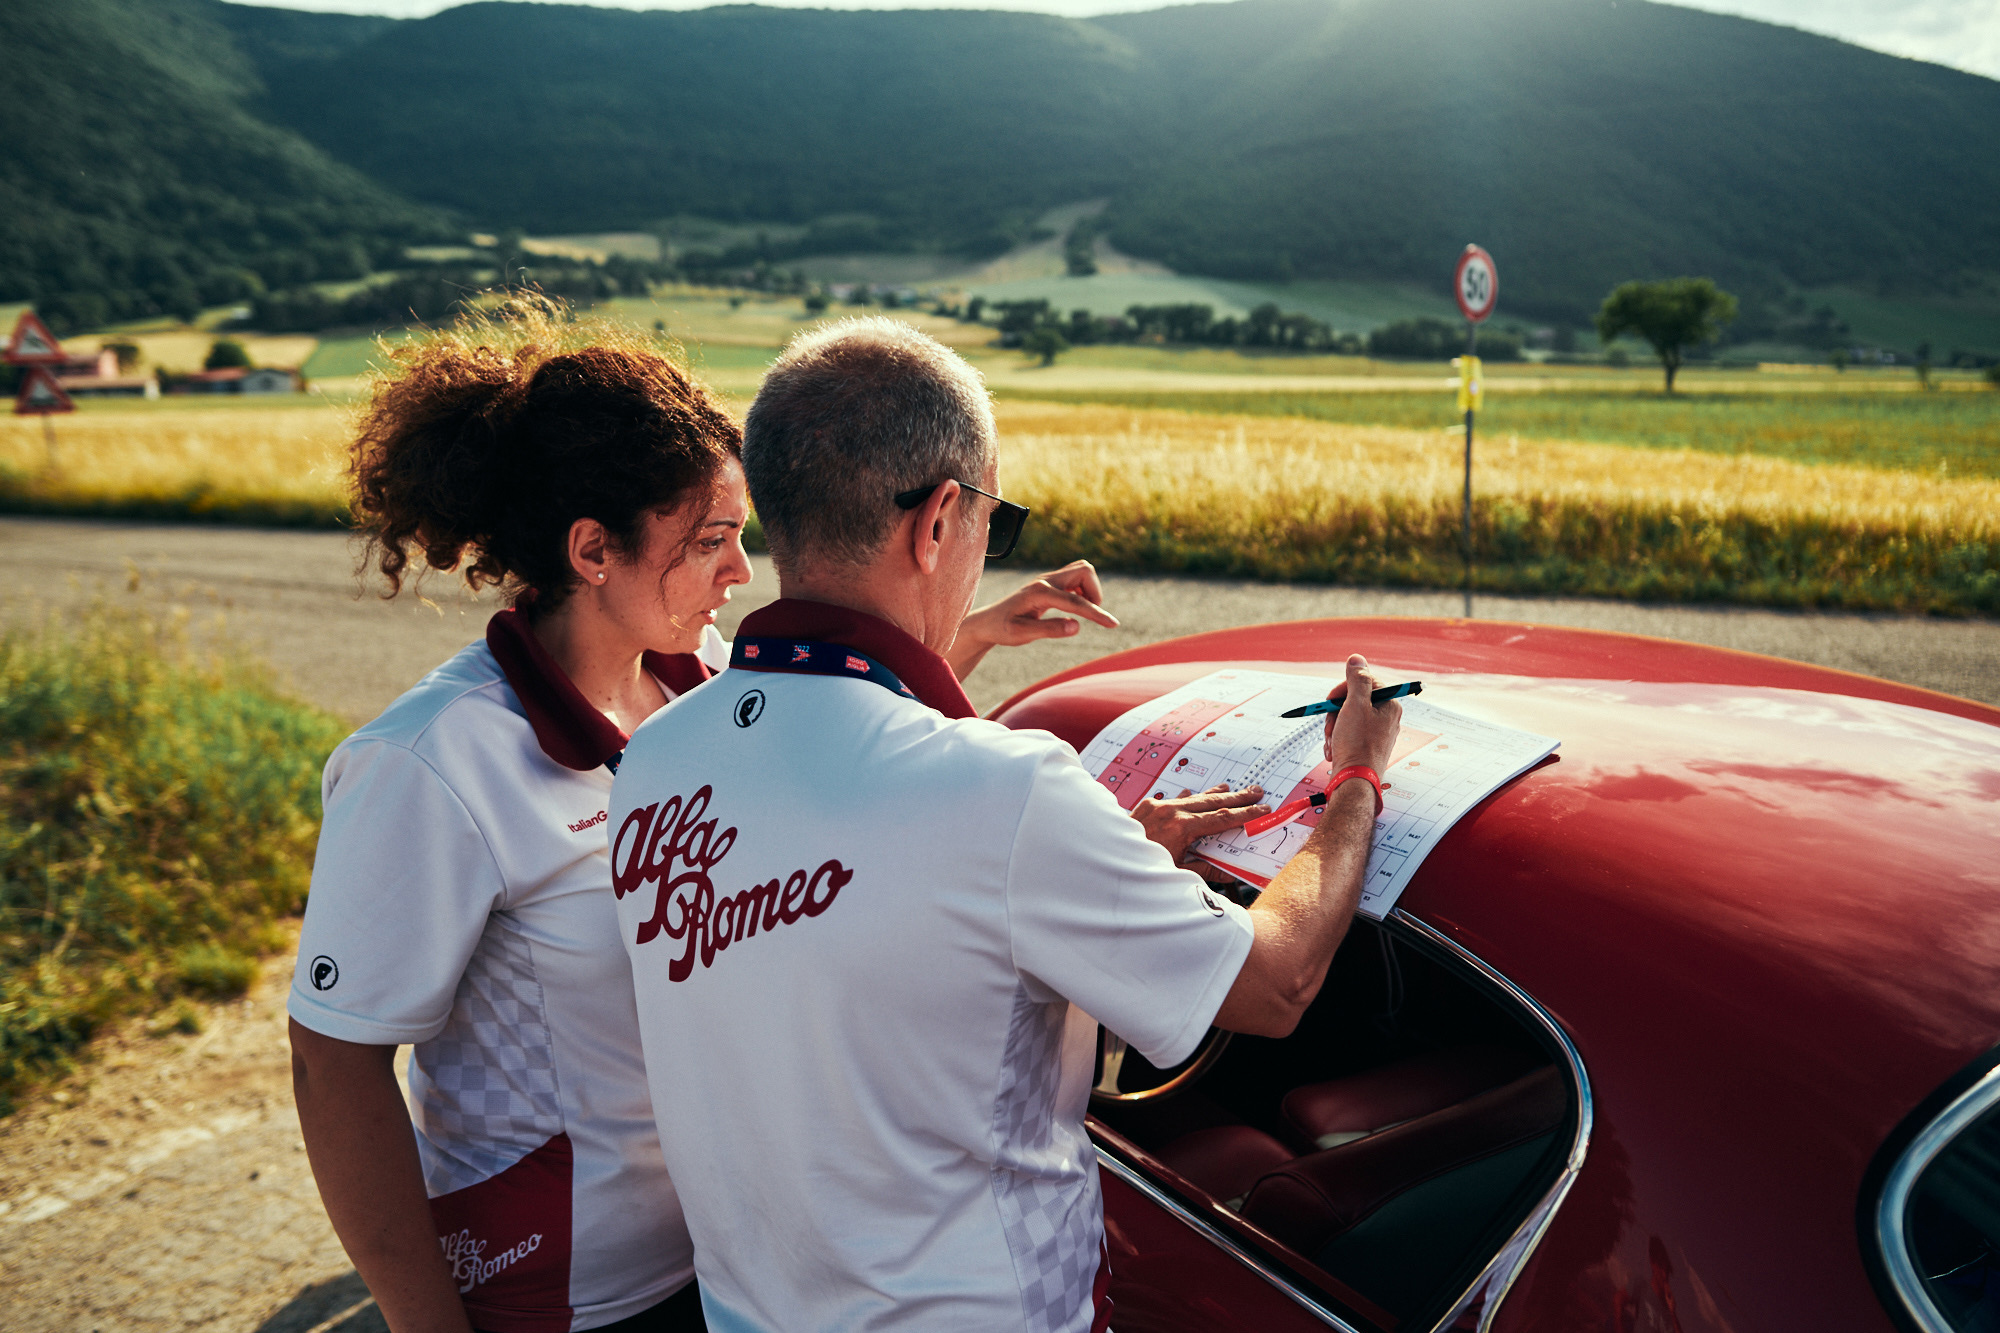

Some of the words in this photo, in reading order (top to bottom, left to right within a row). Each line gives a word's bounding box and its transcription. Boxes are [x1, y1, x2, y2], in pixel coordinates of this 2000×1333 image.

[1466, 267, 1489, 300] 50
[794, 645, 810, 653] 2022
[847, 662, 865, 672] MIGLIA
[848, 657, 865, 666] 1000
[612, 784, 738, 945] Alfa
[660, 858, 854, 983] Romeo
[439, 1228, 487, 1278] lfa
[455, 1233, 543, 1294] Romeo
